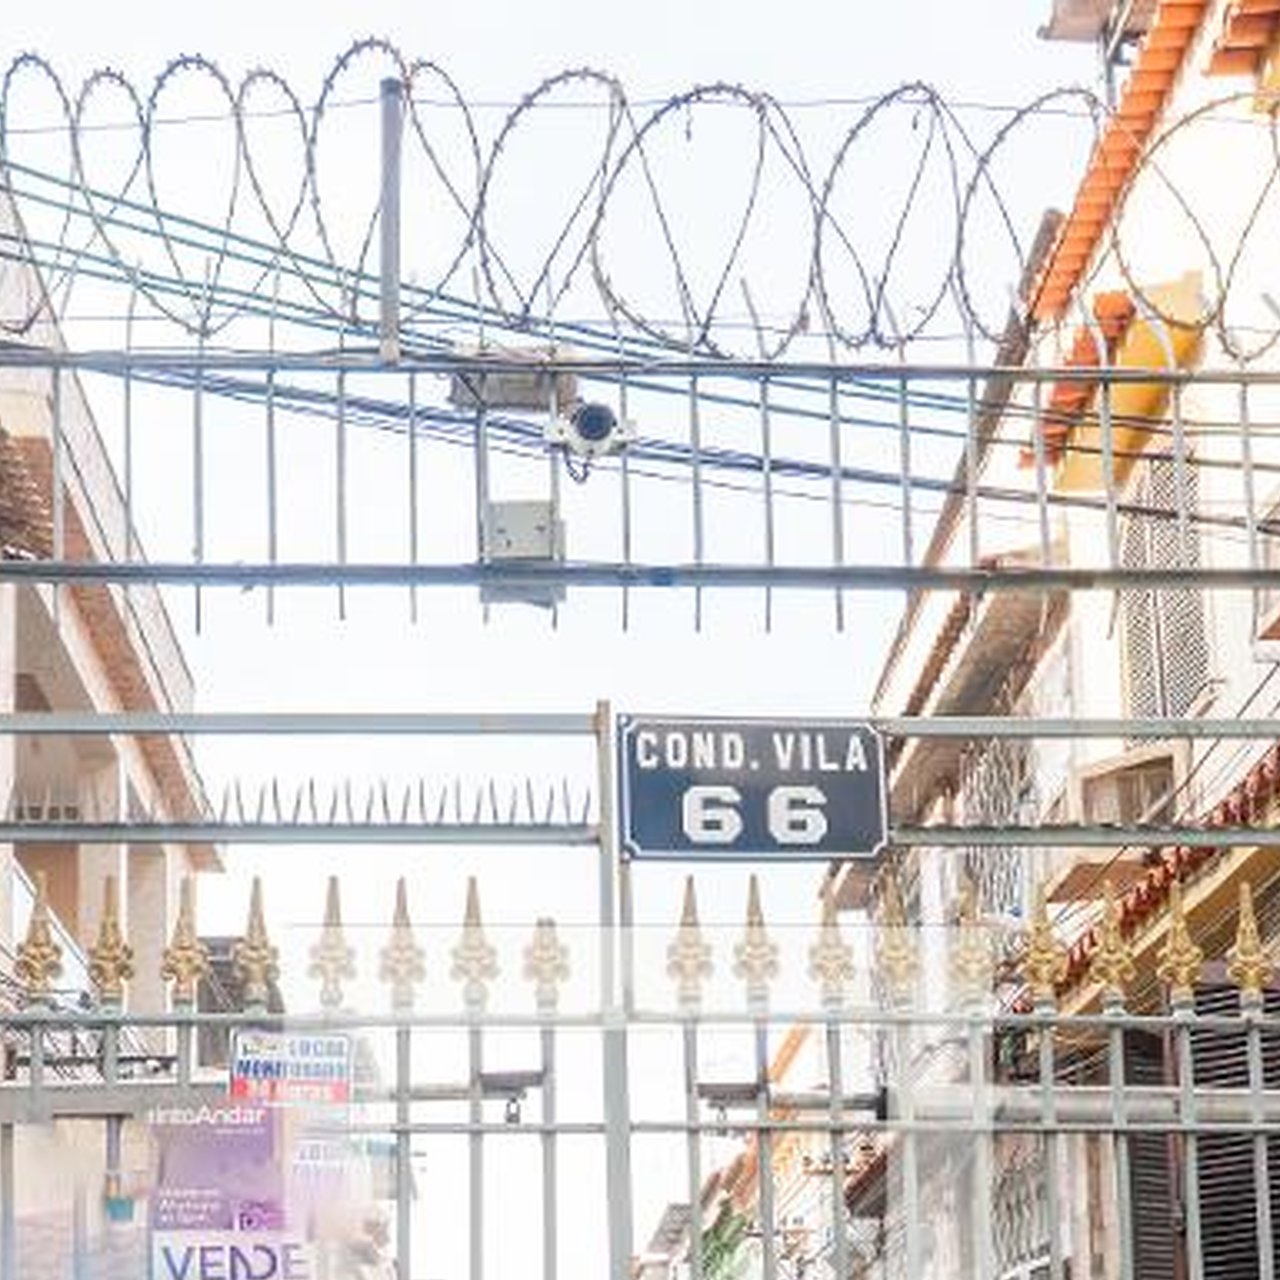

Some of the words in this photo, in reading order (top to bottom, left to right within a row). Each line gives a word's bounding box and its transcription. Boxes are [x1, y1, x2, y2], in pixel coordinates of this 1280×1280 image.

[635, 732, 760, 769] COND.
[773, 733, 869, 772] VILA
[681, 785, 829, 845] 66
